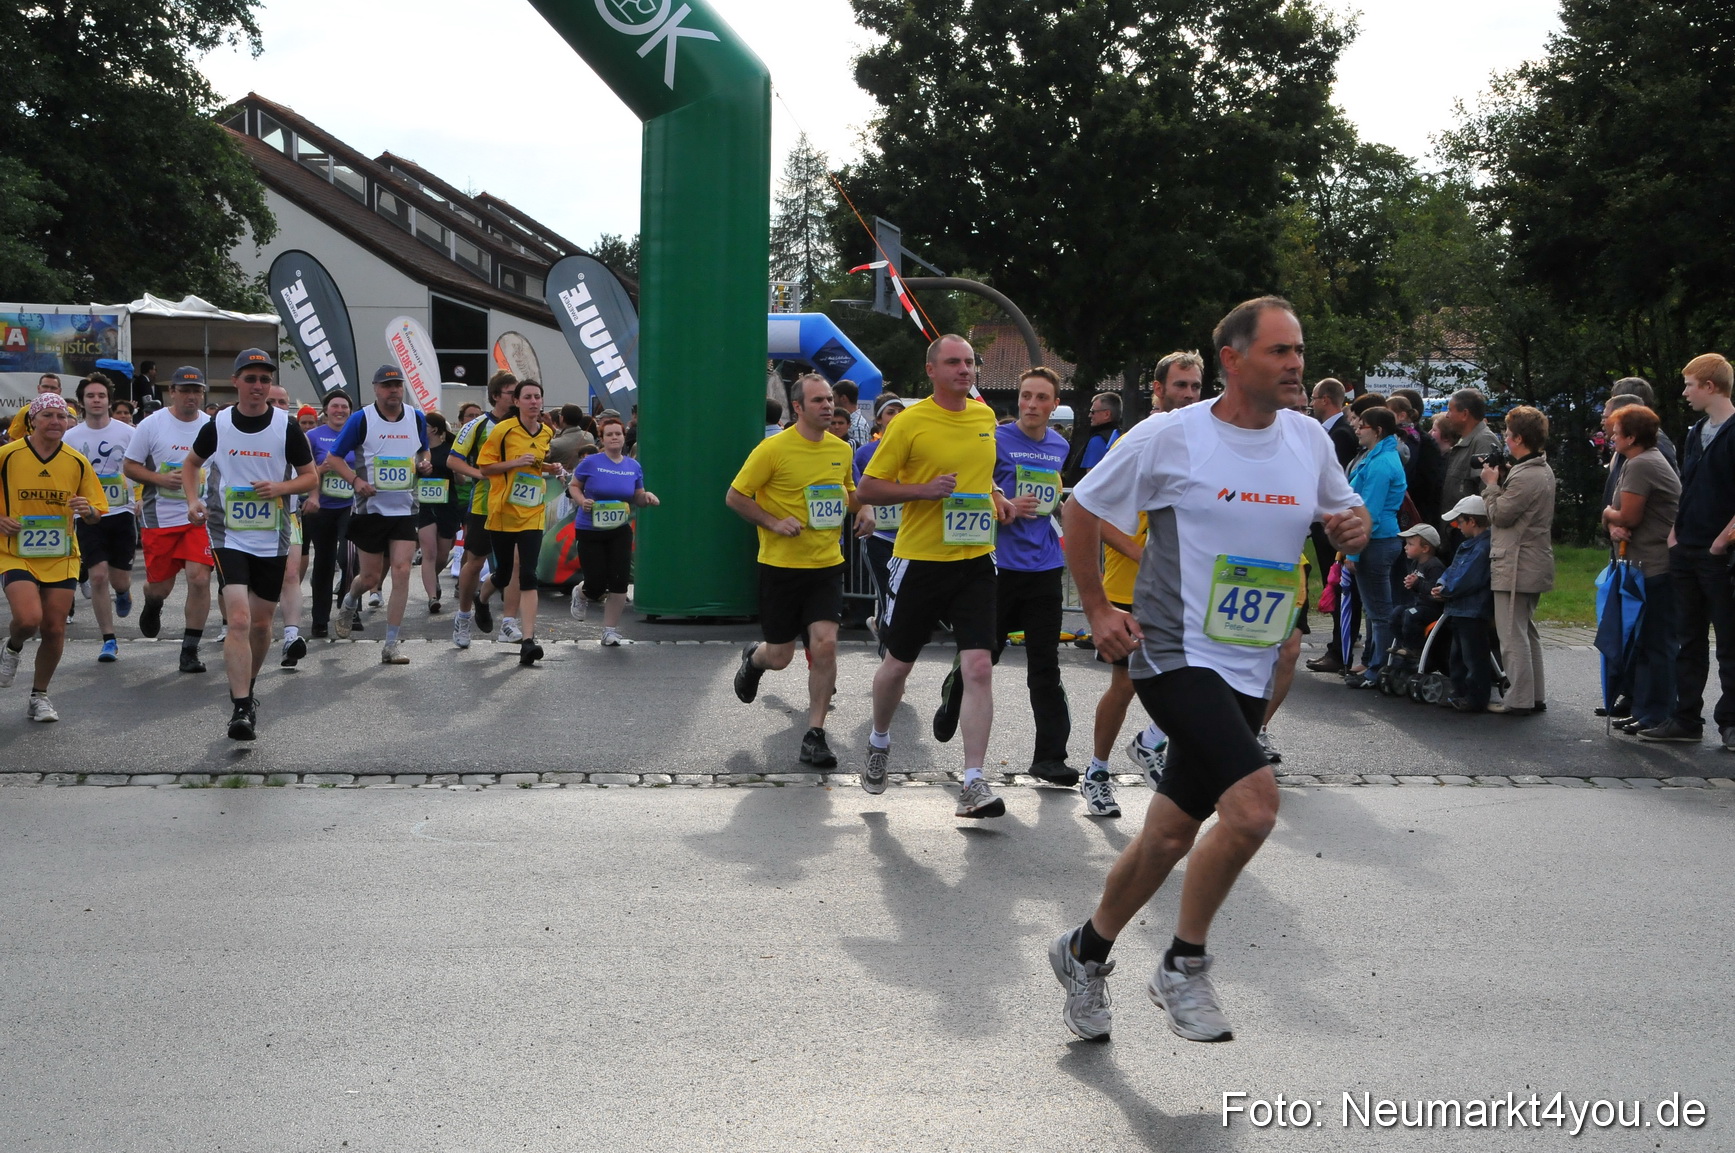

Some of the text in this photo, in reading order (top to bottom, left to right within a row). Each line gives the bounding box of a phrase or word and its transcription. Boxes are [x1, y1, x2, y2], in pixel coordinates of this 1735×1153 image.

[35, 338, 103, 357] Logistics
[239, 450, 272, 458] KLEBL
[1009, 452, 1062, 462] TEPPICHLÄUFER
[379, 468, 407, 482] 508
[20, 490, 65, 501] ONLINE
[421, 486, 442, 497] 550
[513, 483, 536, 500] 221
[1018, 482, 1055, 503] 1309
[1240, 492, 1300, 506] KLEBL
[232, 502, 271, 519] 504
[809, 500, 843, 517] 1284
[873, 506, 904, 520] 131
[595, 510, 625, 522] 1307
[945, 511, 991, 531] 1276
[23, 529, 61, 547] 223
[1217, 587, 1286, 625] 487
[1224, 621, 1245, 632] Peter
